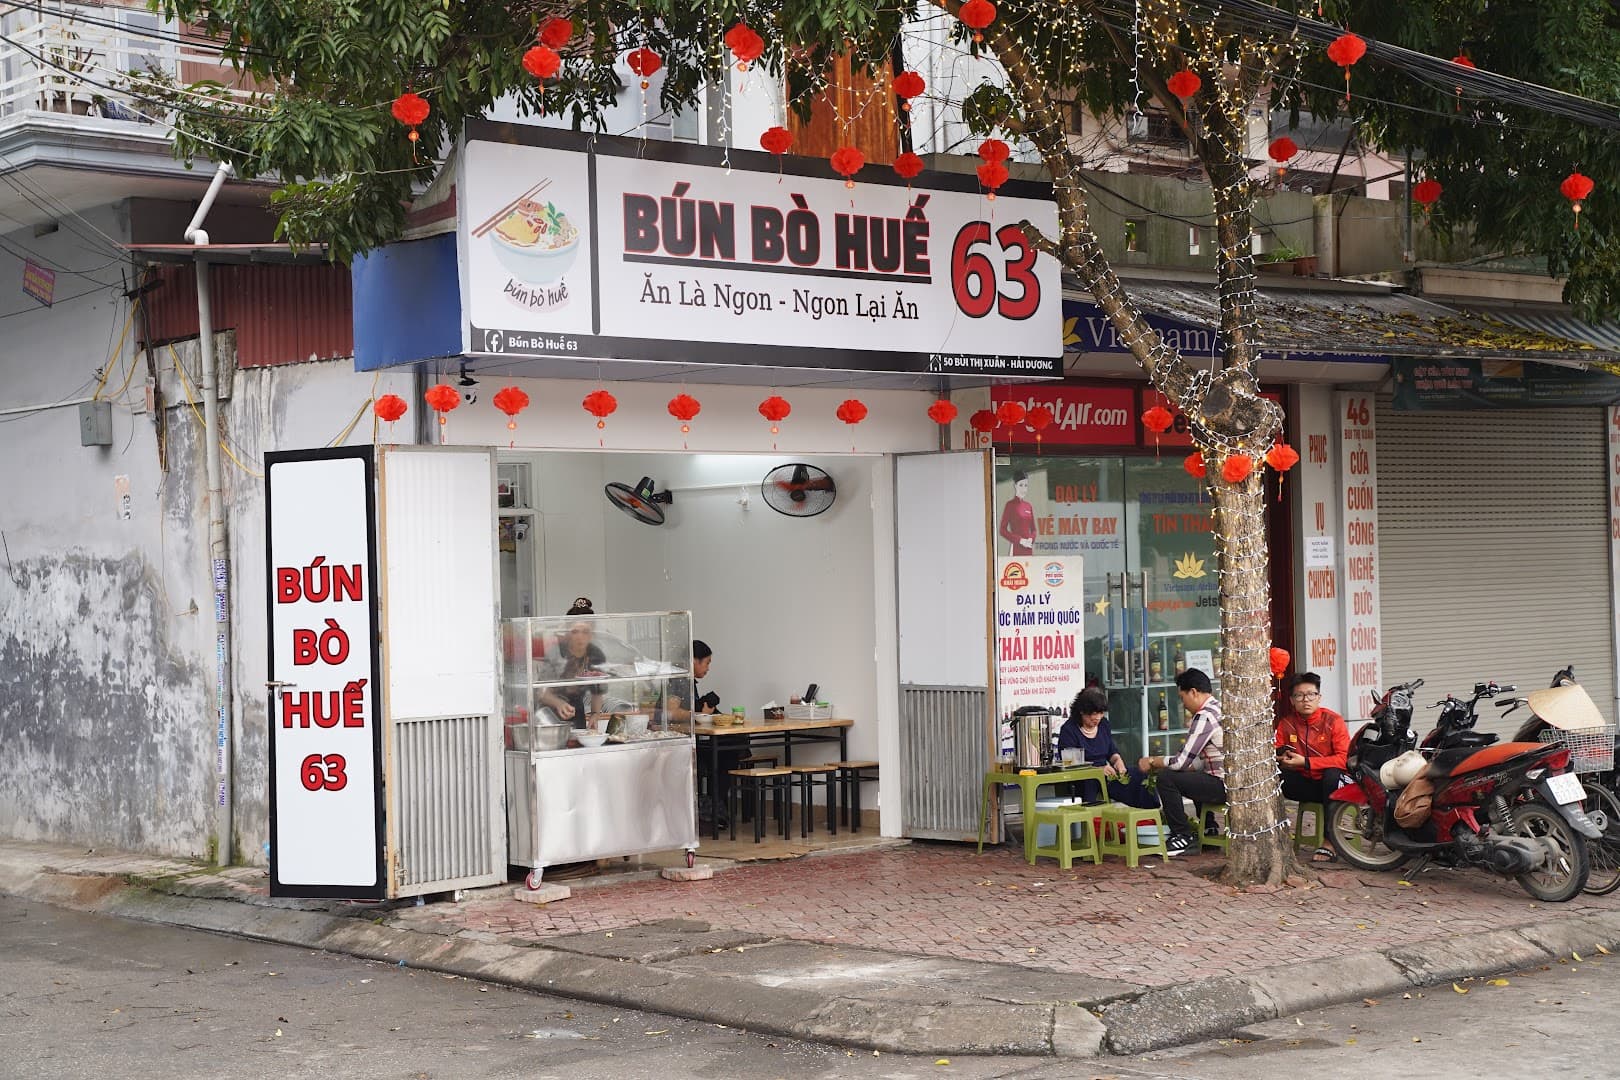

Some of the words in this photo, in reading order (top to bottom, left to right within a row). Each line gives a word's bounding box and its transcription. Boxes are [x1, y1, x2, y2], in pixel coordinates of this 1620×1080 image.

[623, 181, 736, 261] BÚN
[750, 193, 820, 267] BÒ
[834, 194, 931, 275] HUẾ
[950, 220, 1041, 320] 63
[504, 278, 527, 304] bún
[529, 288, 545, 307] bò
[547, 276, 569, 306] huế
[640, 272, 671, 304] Ăn
[679, 280, 706, 307] Là
[714, 284, 772, 315] Ngon
[793, 289, 849, 320] Ngon
[856, 293, 886, 322] Lại
[892, 290, 919, 320] Ăn
[508, 336, 529, 348] Bún
[531, 337, 544, 349] Bò
[545, 335, 565, 351] Huế
[566, 341, 578, 351] 63
[1085, 316, 1211, 351] Viam
[943, 357, 952, 366] 50
[954, 354, 969, 367] BÙI
[970, 358, 983, 371] THỊ
[984, 355, 1006, 369] XUÂN
[1025, 359, 1054, 370] DƯƠNG
[1347, 398, 1370, 426] 46
[1308, 435, 1328, 469] PHỤC
[1350, 443, 1370, 475] CỬA
[1055, 484, 1078, 506] ĐẠI
[1082, 483, 1098, 503] LÝ
[1347, 479, 1374, 510] CUỐN
[1037, 513, 1055, 536] VÉ
[1058, 513, 1088, 536] MÁY
[1092, 517, 1118, 536] BAY
[1315, 502, 1324, 536] VỤ
[1348, 517, 1375, 546] CÔNG
[277, 556, 363, 604] BÚN
[1308, 566, 1336, 599] CHUYÊN
[1349, 552, 1375, 584] NGHỆ
[1016, 594, 1036, 608] ĐẠI
[1039, 590, 1051, 605] LÝ
[1353, 586, 1373, 616] ĐỨC
[1013, 606, 1035, 626] MẮM
[1038, 608, 1055, 625] PHÚ
[1057, 606, 1080, 626] QUỐC
[293, 618, 350, 666] BÒ
[1033, 630, 1075, 660] HOÀN
[1311, 632, 1337, 671] NGHIỆP
[1351, 621, 1377, 651] CÔNG
[282, 679, 368, 728] HUẾ
[300, 754, 348, 792] 63
